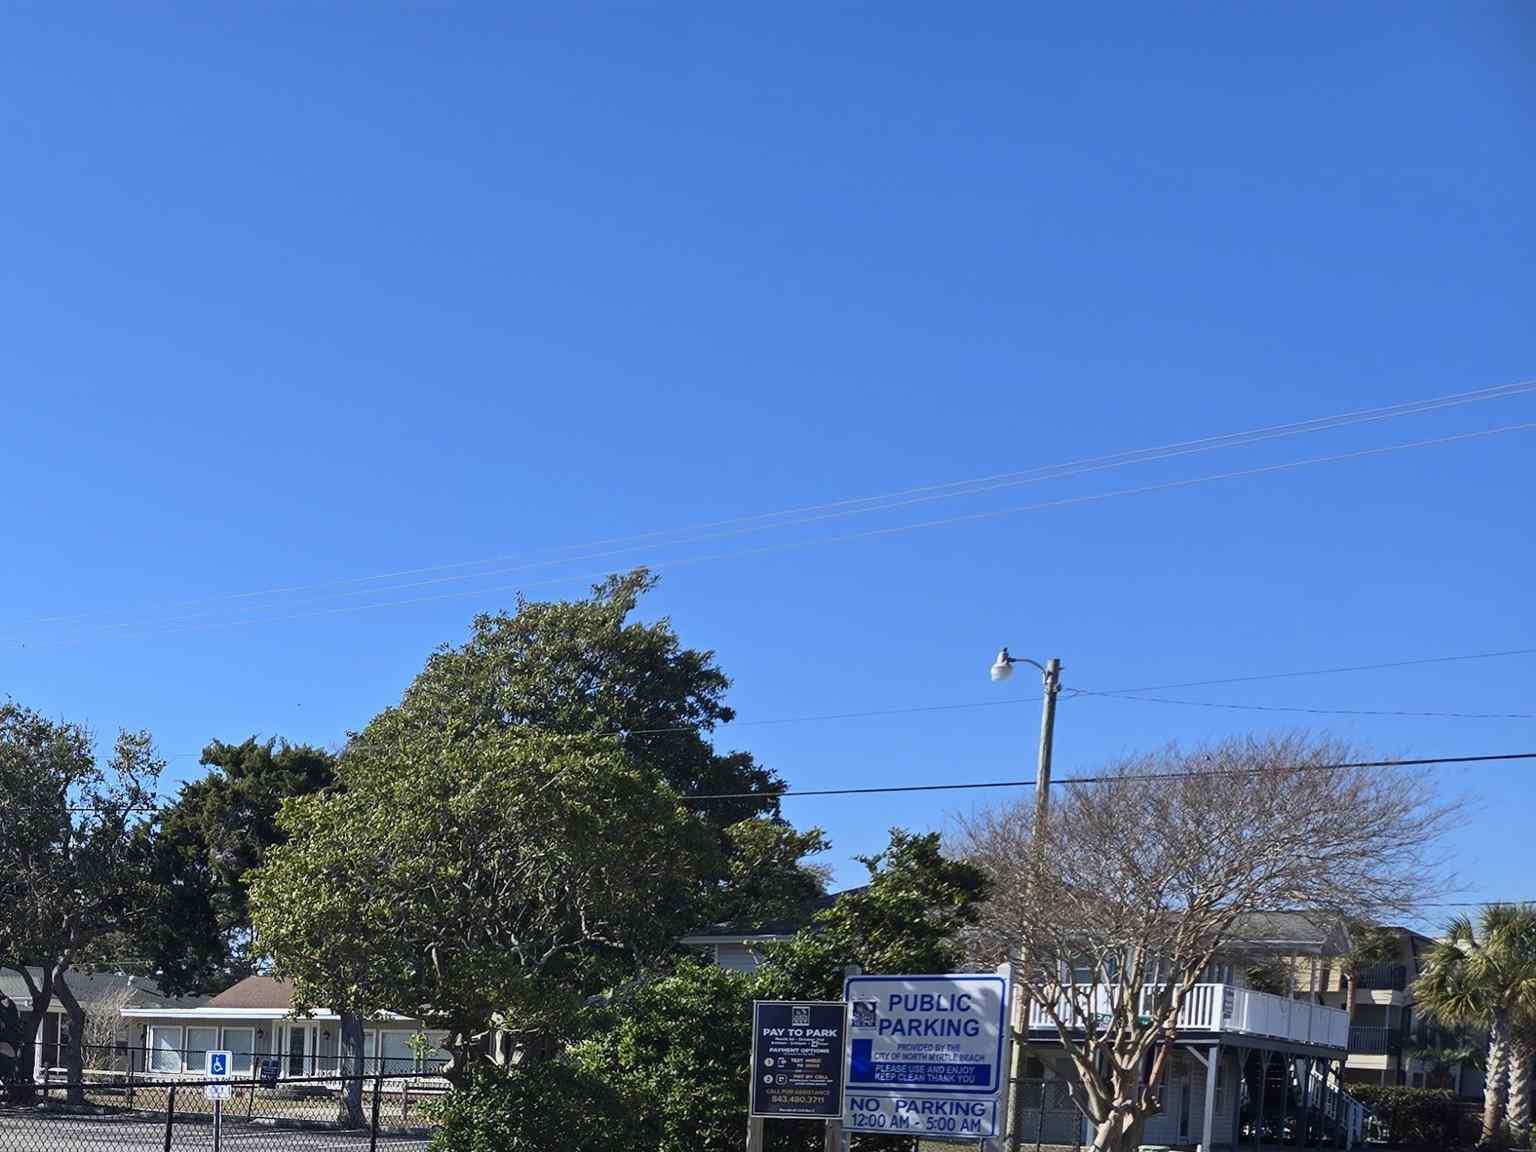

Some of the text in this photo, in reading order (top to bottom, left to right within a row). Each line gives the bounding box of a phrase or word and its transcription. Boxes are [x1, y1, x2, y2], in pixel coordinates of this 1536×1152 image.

[888, 993, 972, 1012] PUBLIC
[763, 1028, 837, 1037] PAY TO PARK
[878, 1018, 980, 1038] PARKING
[897, 1043, 960, 1052] PROVIDED BY THE
[874, 1052, 889, 1060] CITY
[960, 1054, 985, 1062] BEACH
[875, 1064, 976, 1074] PLEASE USE AND ENJOY
[874, 1073, 976, 1084] KEEP CLEAN THANK YOU
[850, 1098, 986, 1117] NO PARKING
[852, 1113, 886, 1127] 12:00
[890, 1115, 910, 1128] AM
[926, 1117, 955, 1131] 5:00
[960, 1119, 981, 1132] AM
